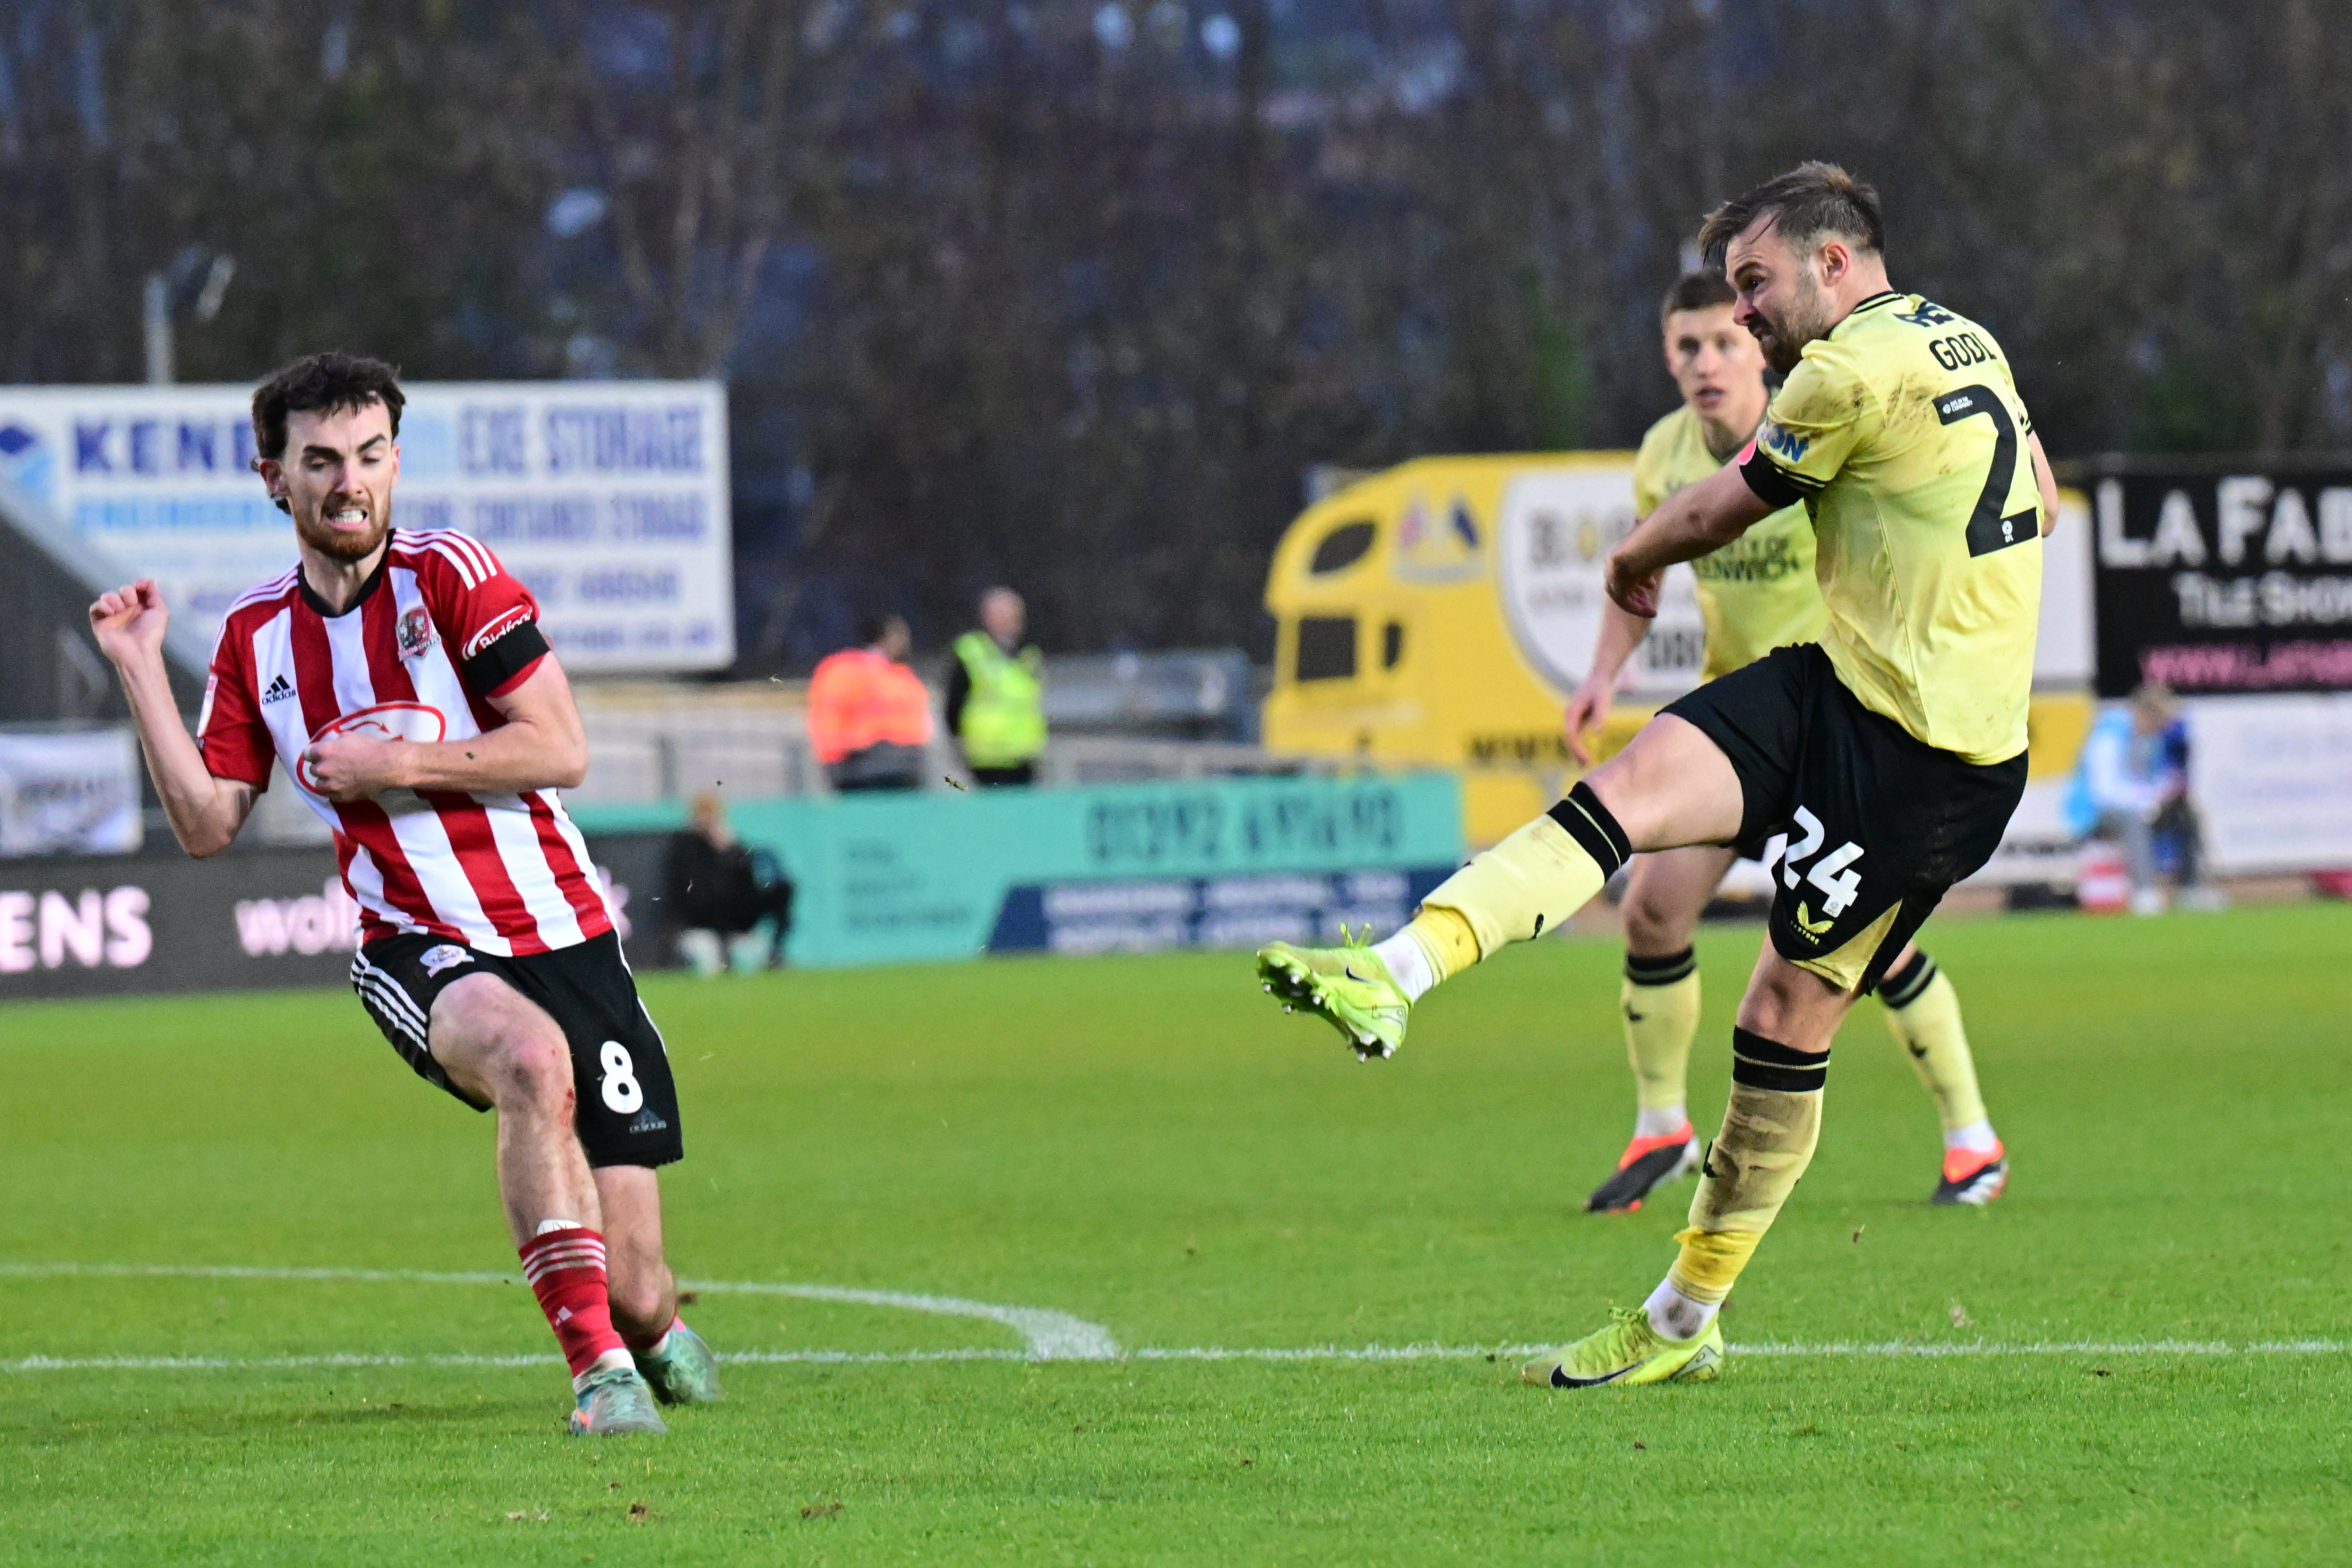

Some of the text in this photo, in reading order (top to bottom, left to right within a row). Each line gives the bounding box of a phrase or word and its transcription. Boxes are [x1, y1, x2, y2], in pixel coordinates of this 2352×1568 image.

[2095, 478, 2207, 567] LA
[262, 689, 296, 705] adidas
[1785, 805, 1864, 918] 24
[601, 1041, 643, 1114] 8
